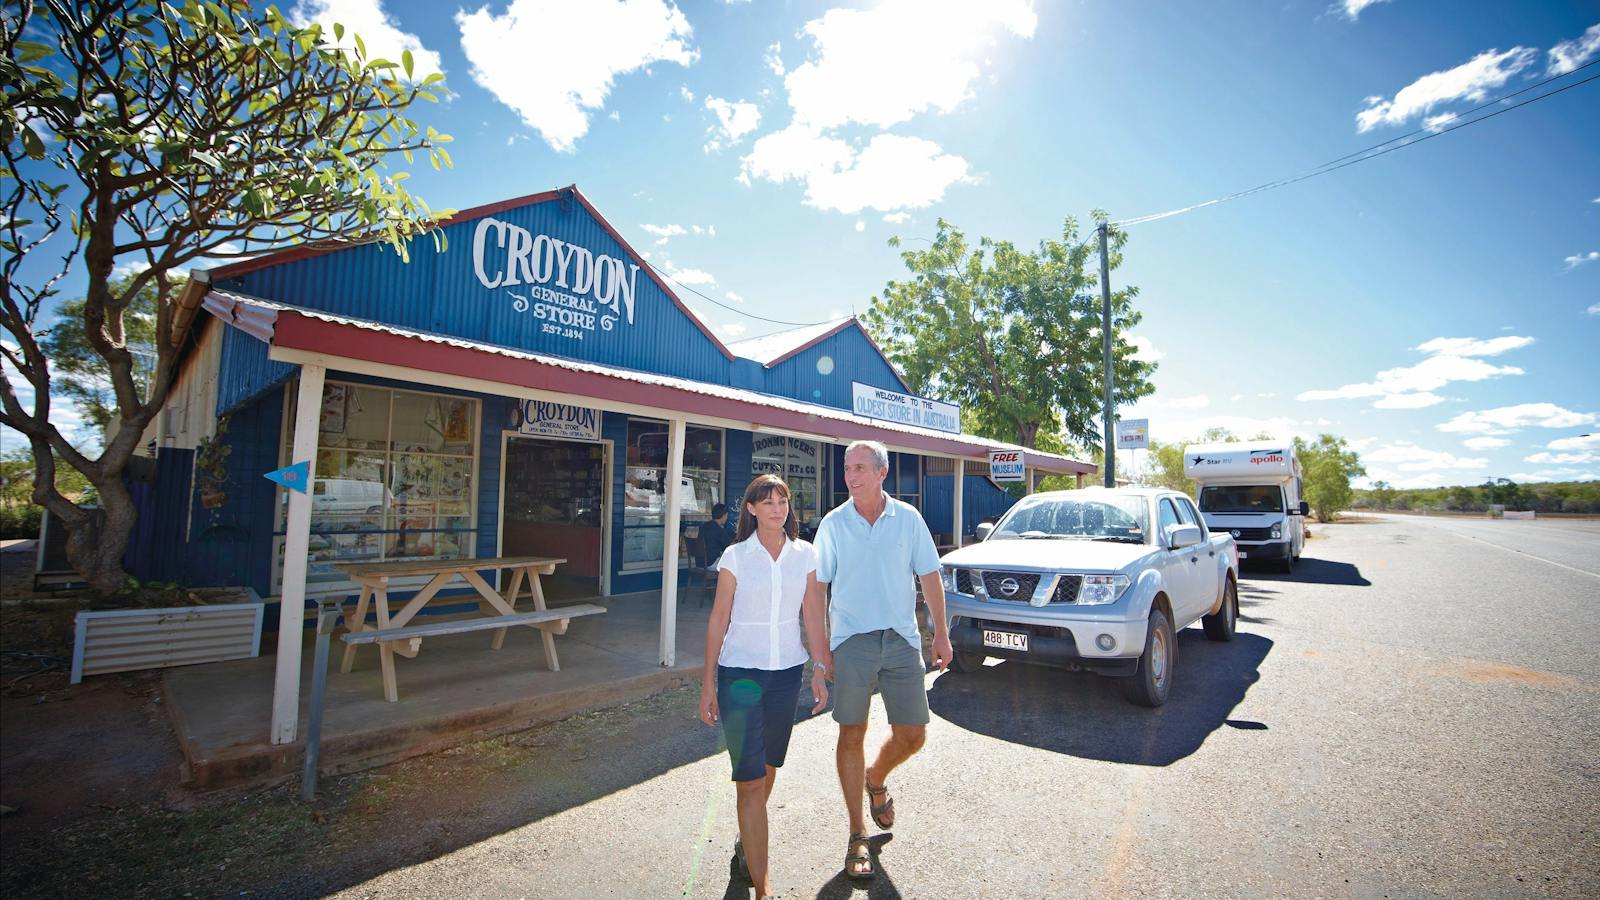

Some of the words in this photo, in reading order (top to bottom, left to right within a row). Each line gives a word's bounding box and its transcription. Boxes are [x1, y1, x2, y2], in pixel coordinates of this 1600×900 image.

[473, 217, 640, 325] CROYDON
[531, 286, 597, 314] GENERAL
[533, 302, 596, 331] STORE
[542, 323, 584, 340] EST.1894
[875, 390, 905, 404] WELCOME
[910, 397, 919, 407] TO
[921, 400, 933, 410] THE
[525, 400, 595, 432] CROYDON
[857, 396, 886, 416] OLDEST
[887, 403, 912, 422] STORE
[913, 408, 920, 423] IN
[924, 411, 955, 430] AUSTRALIA
[540, 421, 562, 429] GENERAL
[751, 436, 816, 456] IRONMONGERS
[752, 461, 799, 474] CUTHRT
[992, 453, 1020, 463] FREE
[1249, 455, 1284, 465] apollo
[992, 464, 1024, 474] MUSEUM
